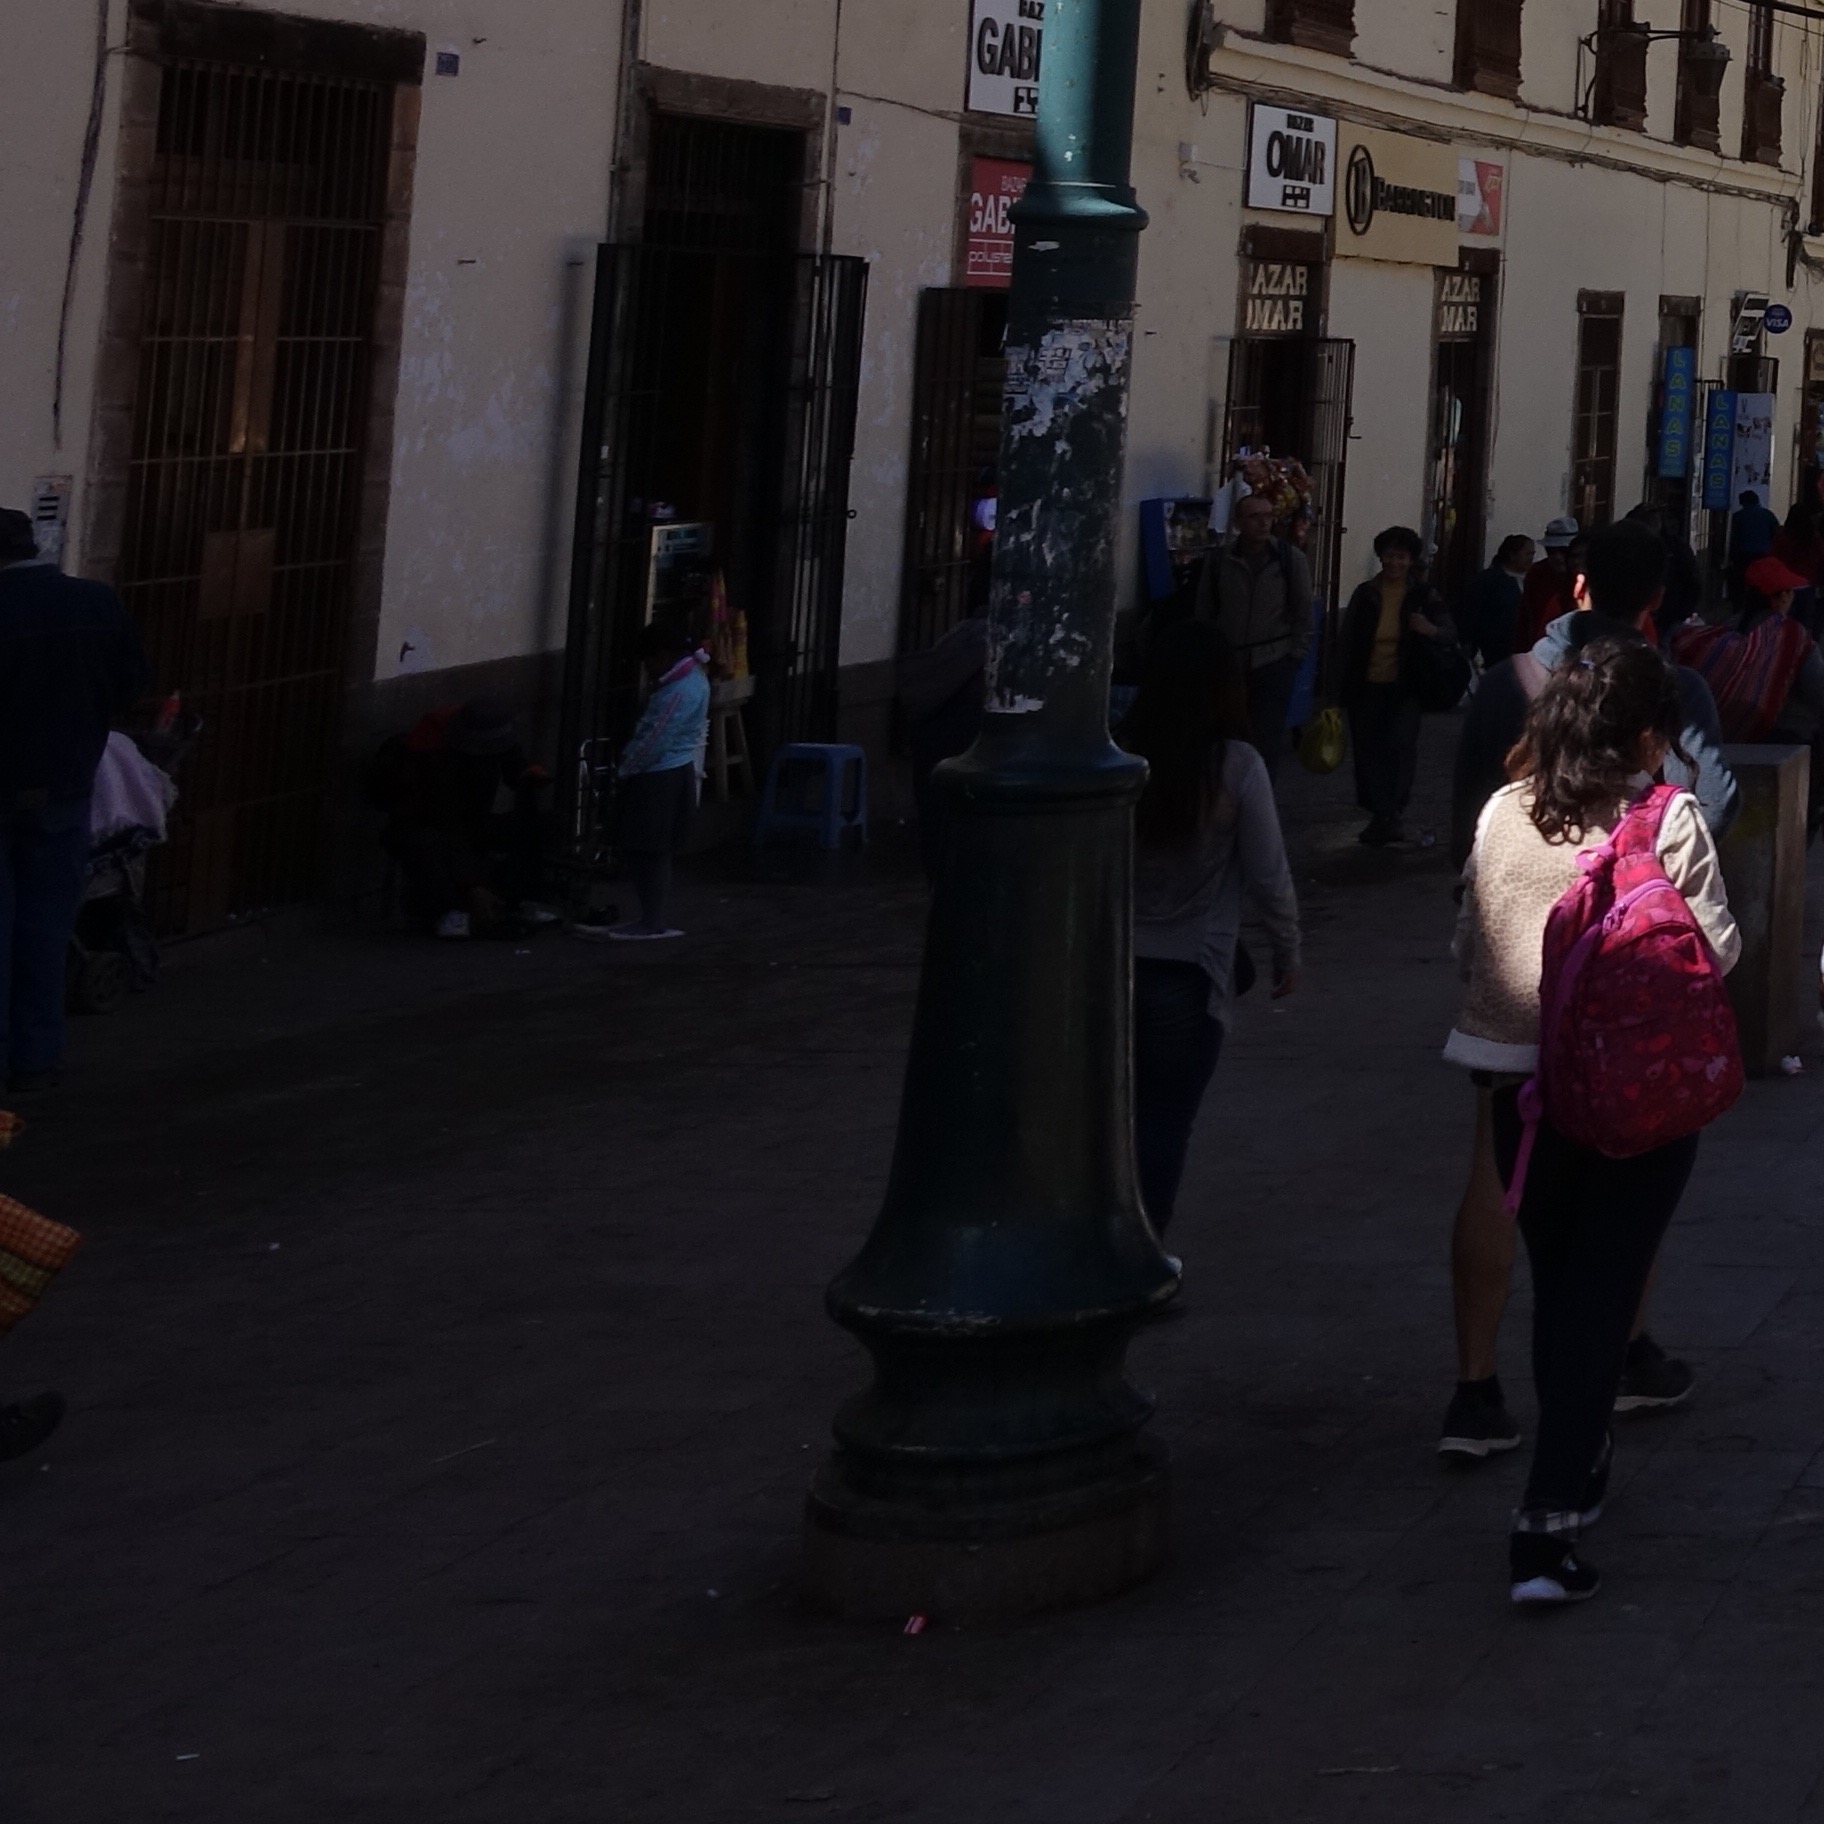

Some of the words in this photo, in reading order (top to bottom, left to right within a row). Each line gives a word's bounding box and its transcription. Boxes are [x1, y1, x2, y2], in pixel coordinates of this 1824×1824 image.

[1266, 131, 1325, 184] OMAR
[970, 192, 1015, 234] GAB
[1250, 263, 1308, 295] AZAR
[1765, 318, 1789, 328] VISA
